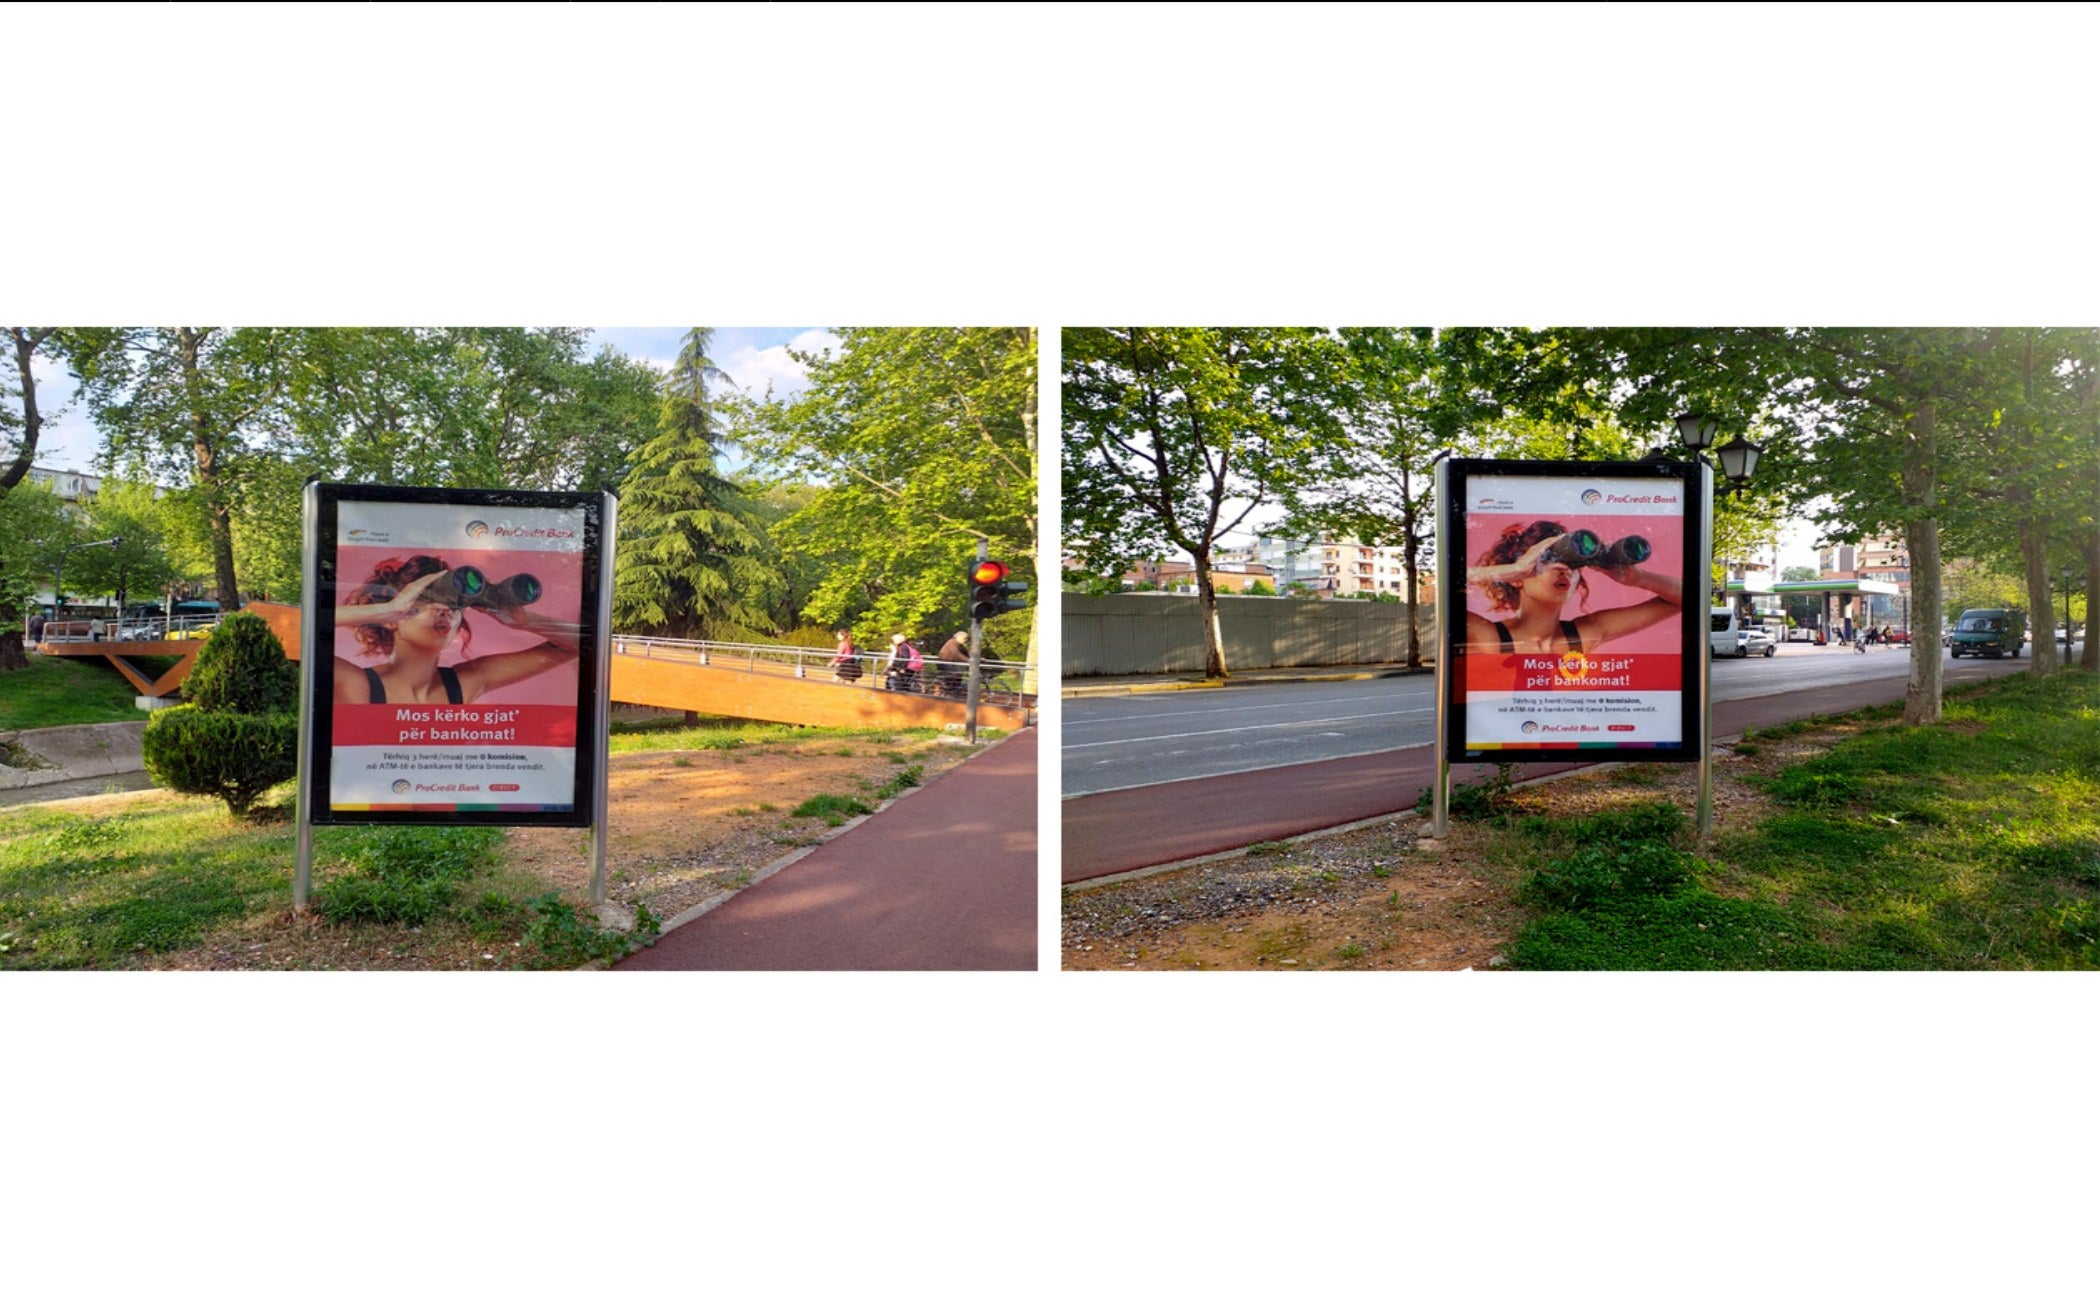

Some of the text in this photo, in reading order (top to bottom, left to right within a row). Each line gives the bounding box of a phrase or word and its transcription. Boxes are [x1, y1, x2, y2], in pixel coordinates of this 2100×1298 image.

[1607, 494, 1678, 504] ProCredit Bank
[547, 528, 575, 538] Bank
[1524, 658, 1554, 670] Mos
[1558, 658, 1597, 670] kërko
[1527, 674, 1630, 688] për bankomat!
[396, 709, 430, 722] Mos
[435, 708, 480, 722] kërko
[1542, 724, 1578, 732] ProCredit
[400, 728, 515, 742] për bankomat!
[416, 784, 456, 792] ProCredit
